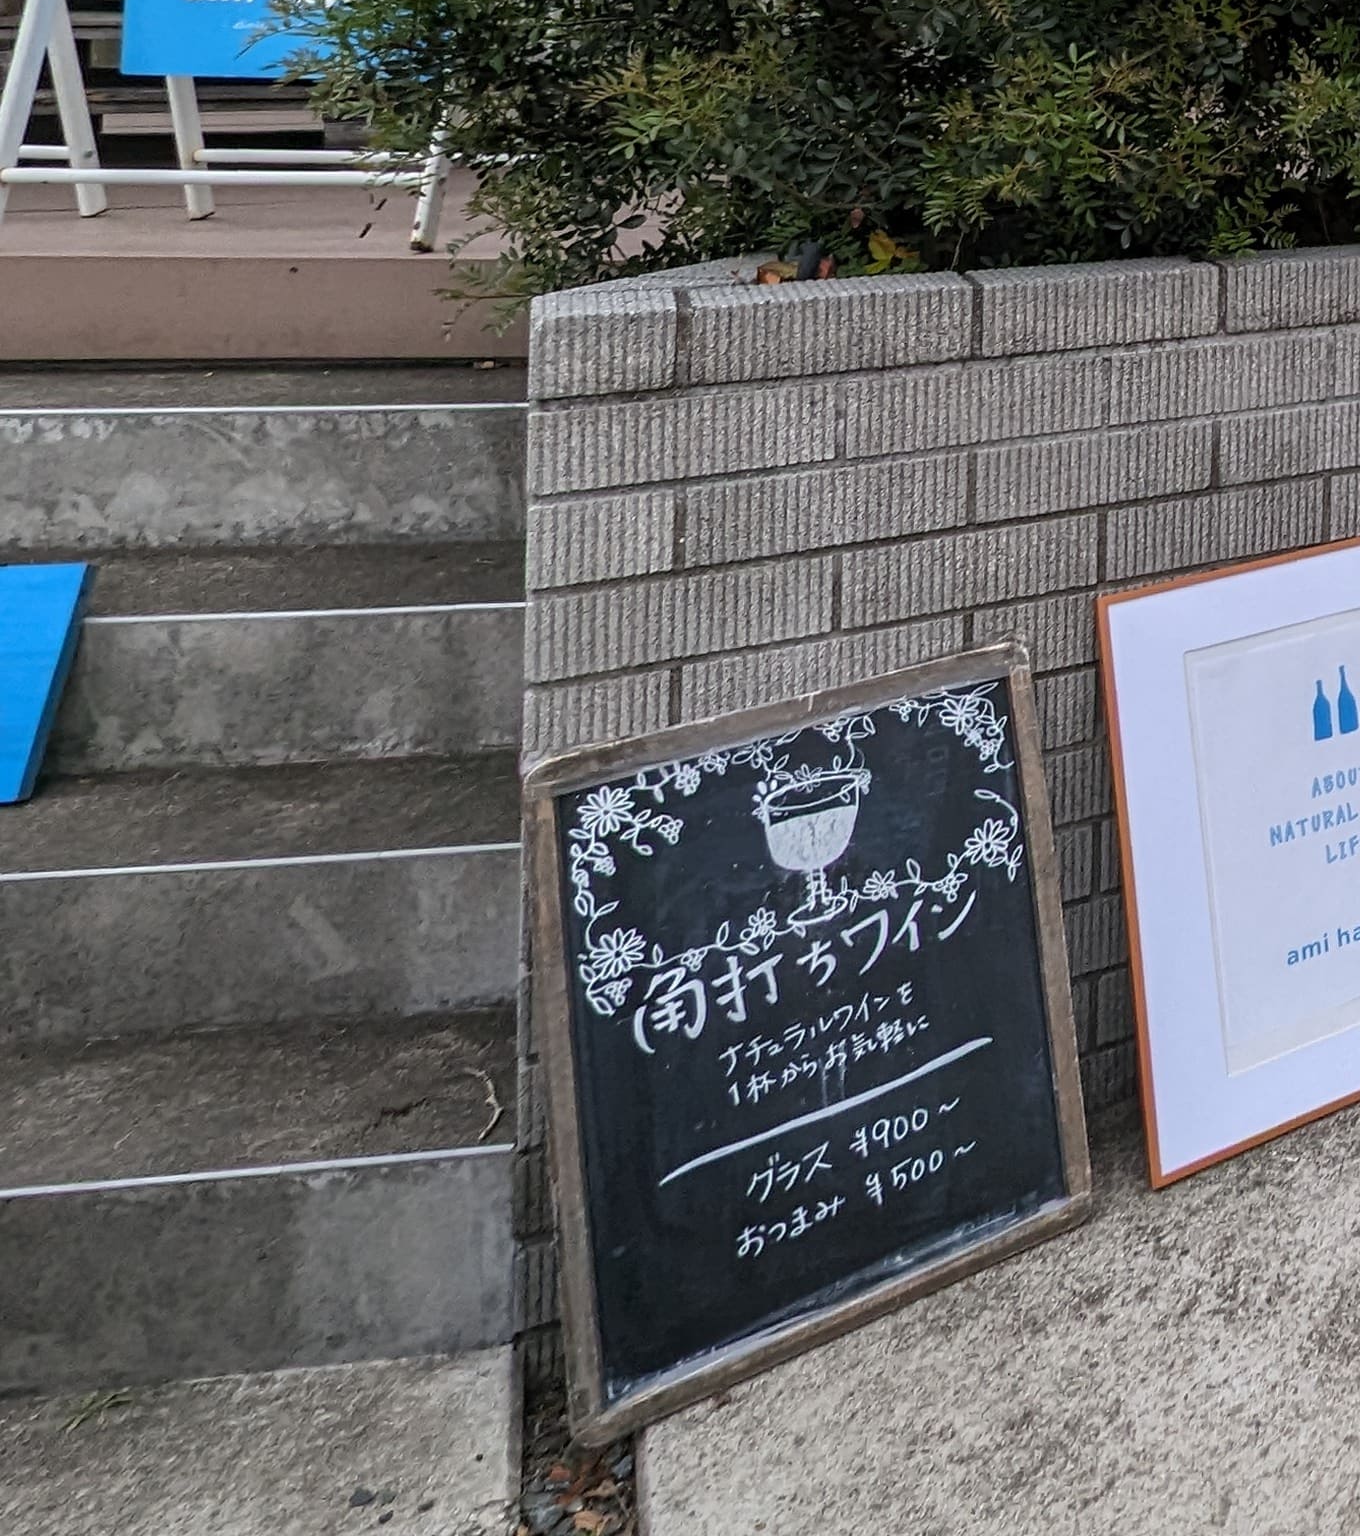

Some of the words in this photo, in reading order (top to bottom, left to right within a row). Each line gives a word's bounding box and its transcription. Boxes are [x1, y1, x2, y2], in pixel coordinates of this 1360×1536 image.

[1269, 801, 1359, 847] NATURAL
[633, 890, 977, 1054] 角打ちワイン
[1287, 932, 1330, 966] ami
[718, 981, 914, 1076] ナチュラルワインを
[727, 1014, 930, 1107] 1杯からお気軽に
[745, 1141, 833, 1204] グラス
[736, 1195, 847, 1259] おつまみ
